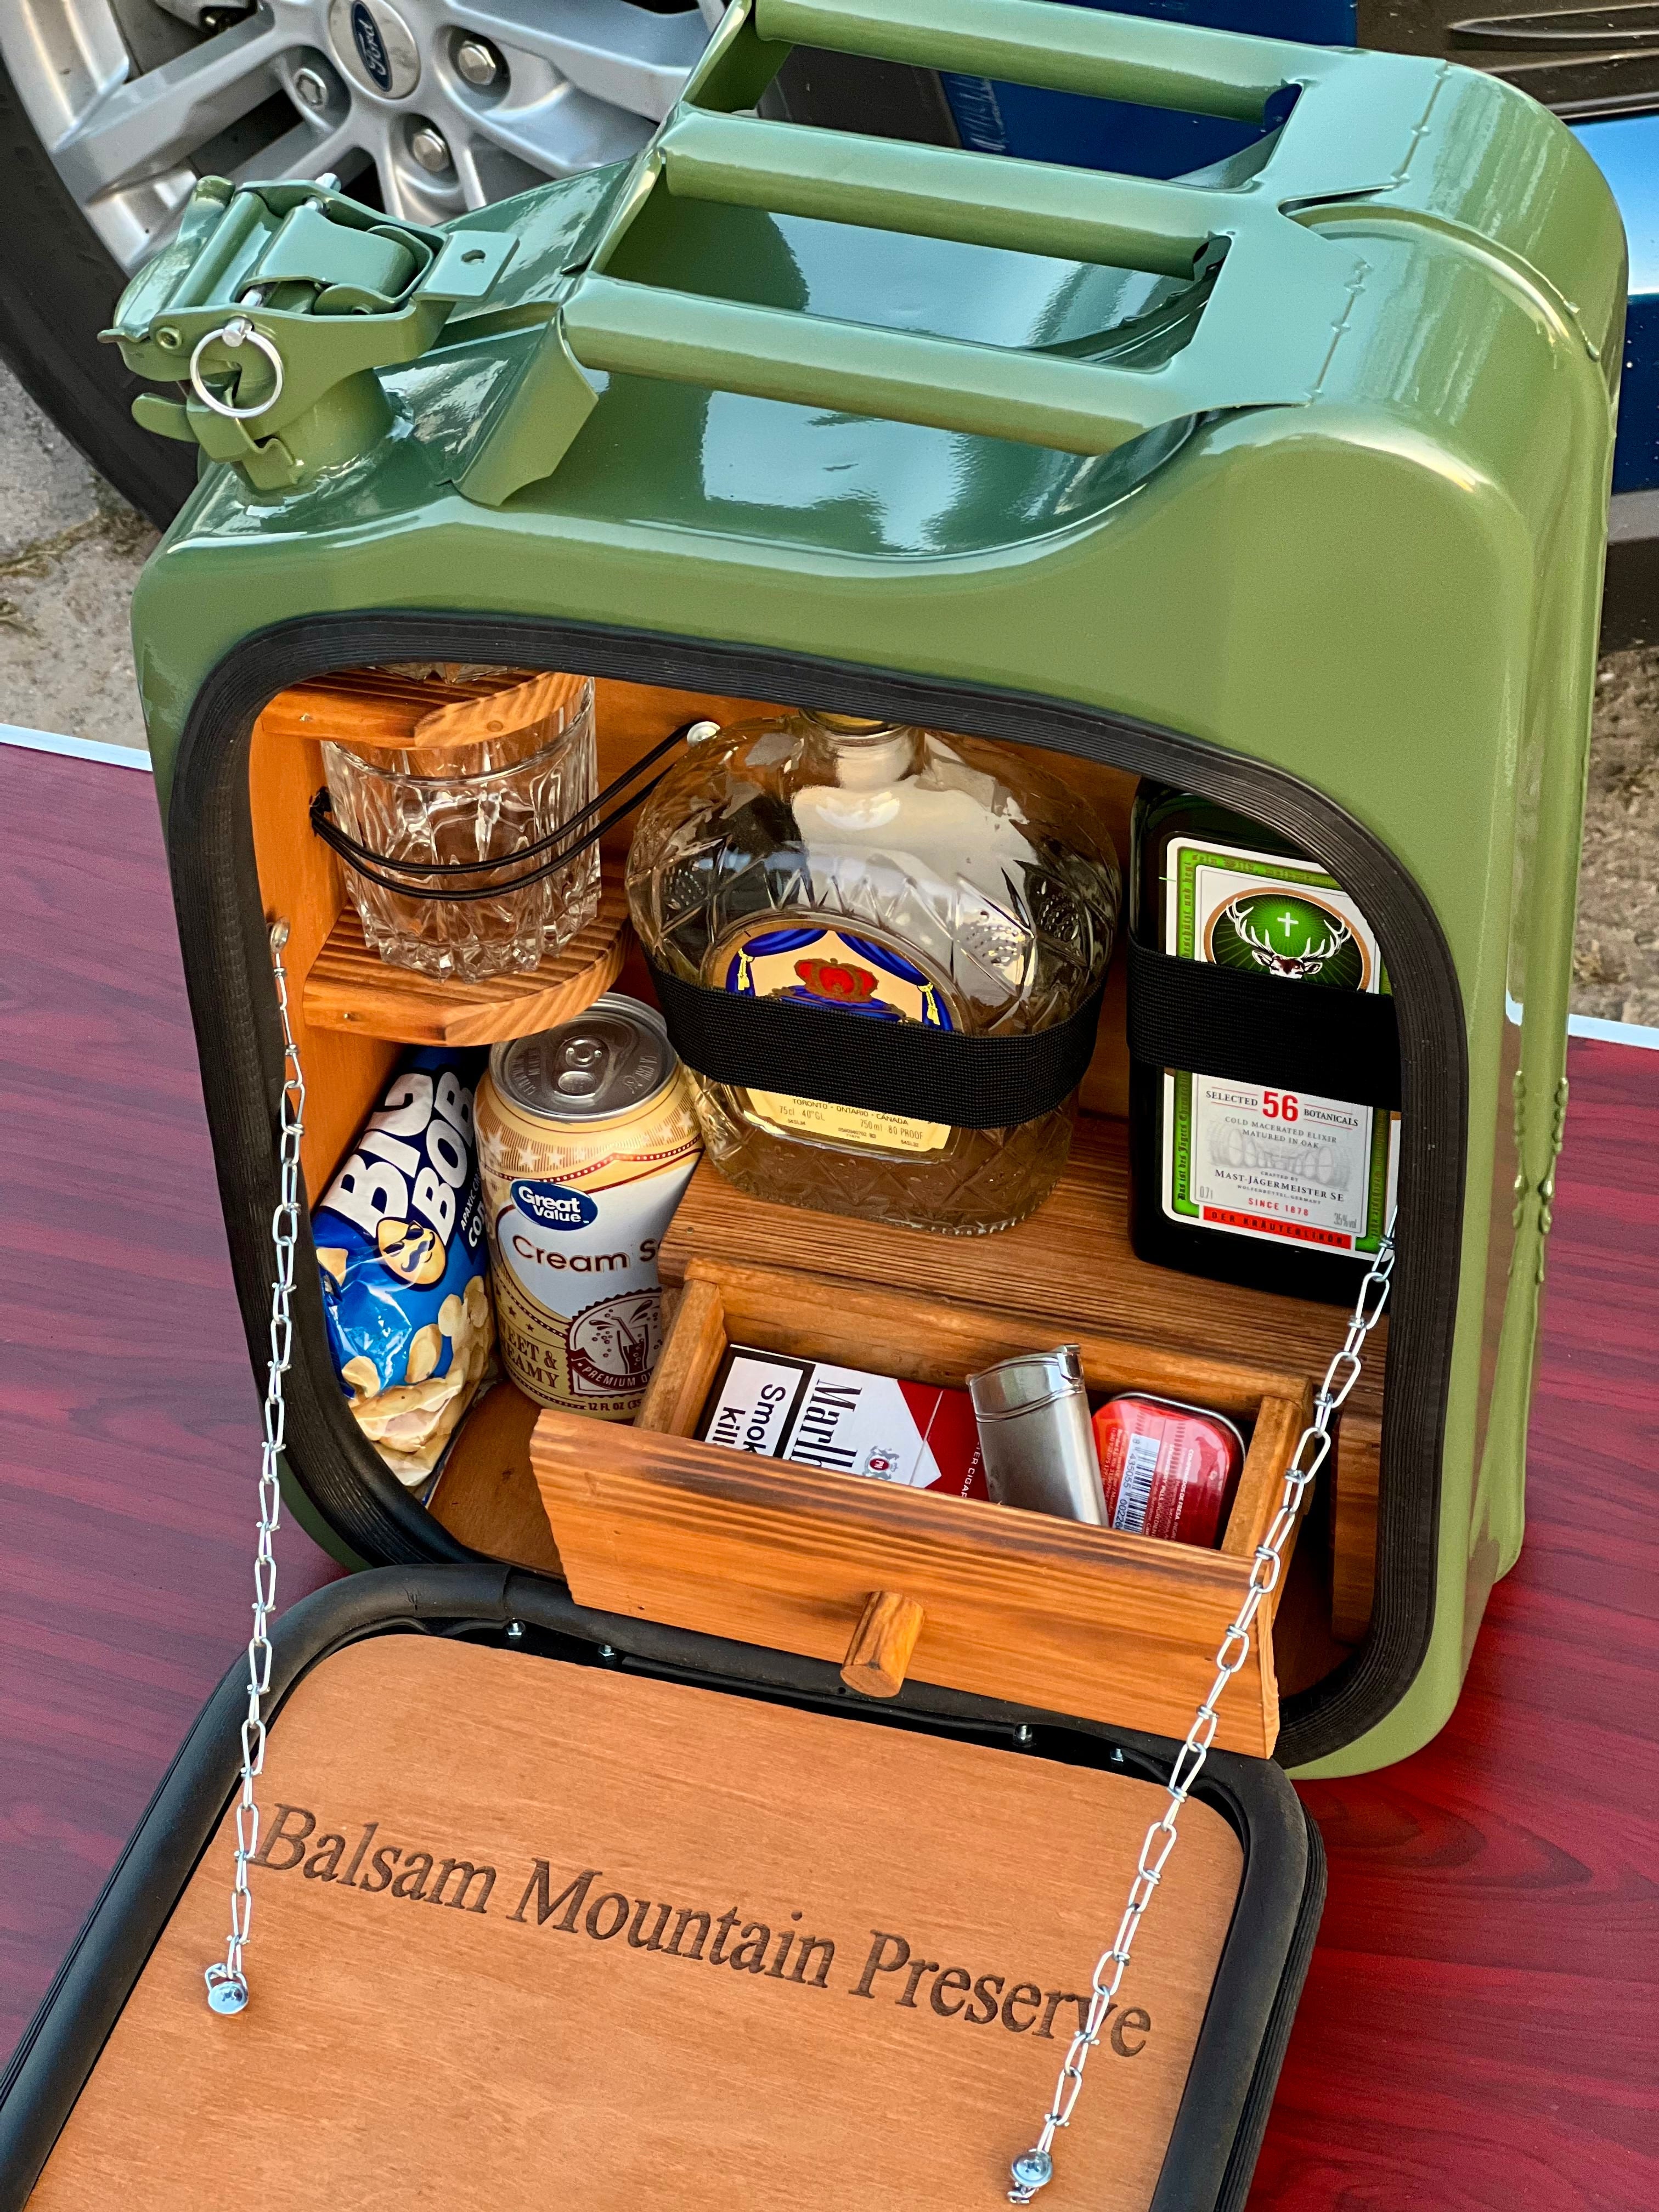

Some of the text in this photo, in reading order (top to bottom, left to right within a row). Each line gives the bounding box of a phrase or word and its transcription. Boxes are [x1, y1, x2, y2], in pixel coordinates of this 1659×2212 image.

[358, 18, 386, 75] Ford
[793, 1099, 909, 1125] TORONTO ONTARIO CANADA
[1206, 1091, 1358, 1126] SELECTED 56 BOTANICALS
[888, 1126, 898, 1135] 80
[900, 1128, 923, 1139] PROOF
[1225, 1116, 1336, 1143] COLD MACERATED ELIXIR
[1242, 1129, 1285, 1142] MATURED
[1301, 1140, 1319, 1149] OAK
[320, 1073, 433, 1238] BIG
[411, 1071, 474, 1246] BOB
[1215, 1169, 1344, 1202] MAST-JÄGERMEISTER SE
[1260, 1171, 1288, 1181] CRAFTED
[518, 1186, 580, 1213] Great
[1249, 1198, 1308, 1216] SINCE 1878
[1290, 1195, 1321, 1205] GERMANY
[533, 1205, 582, 1222] Value
[1211, 1211, 1235, 1223] DER
[512, 1235, 629, 1272] Cream
[544, 1350, 558, 1370] &
[582, 1366, 635, 1387] PREMIUM
[613, 1402, 624, 1410] OZ
[712, 1406, 746, 1445] kill
[1124, 1453, 1136, 1488] 435055
[1180, 1448, 1194, 1493] COMPRIMIDOS
[1178, 1493, 1184, 1502] DE
[1115, 1499, 1127, 1530] 00226
[256, 1803, 1153, 2058] Balsam Mountain Preserve
